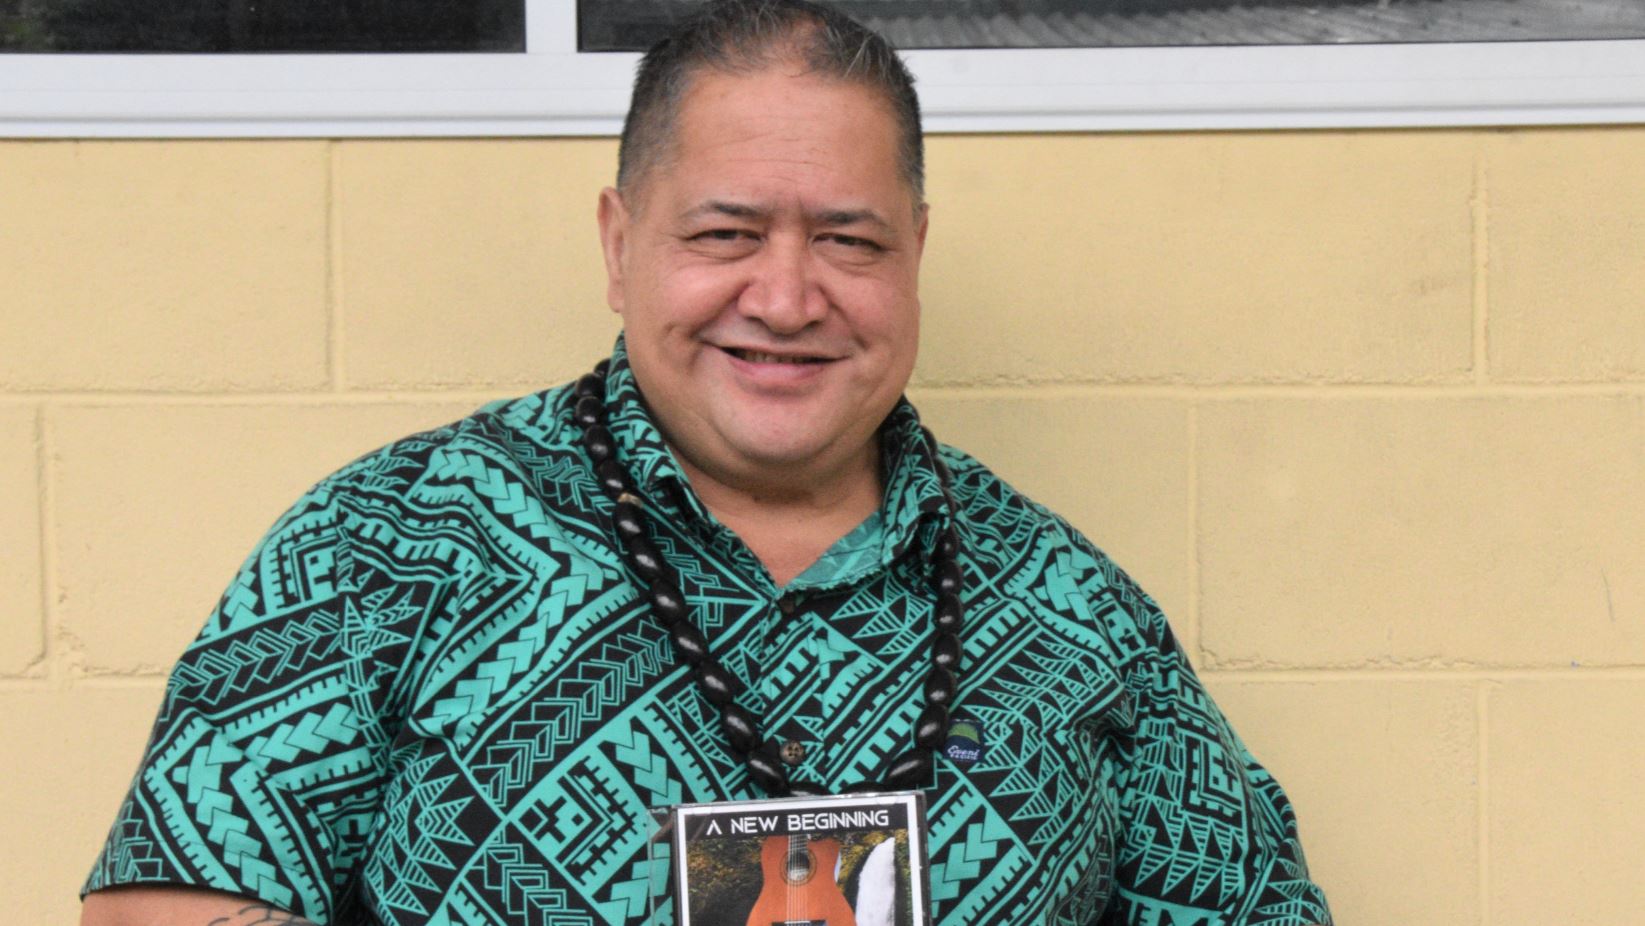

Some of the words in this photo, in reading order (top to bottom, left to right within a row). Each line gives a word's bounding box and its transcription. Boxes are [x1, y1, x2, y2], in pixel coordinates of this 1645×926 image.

[706, 818, 722, 835] A
[731, 815, 778, 834] NEW
[787, 810, 889, 831] BEGINNING
